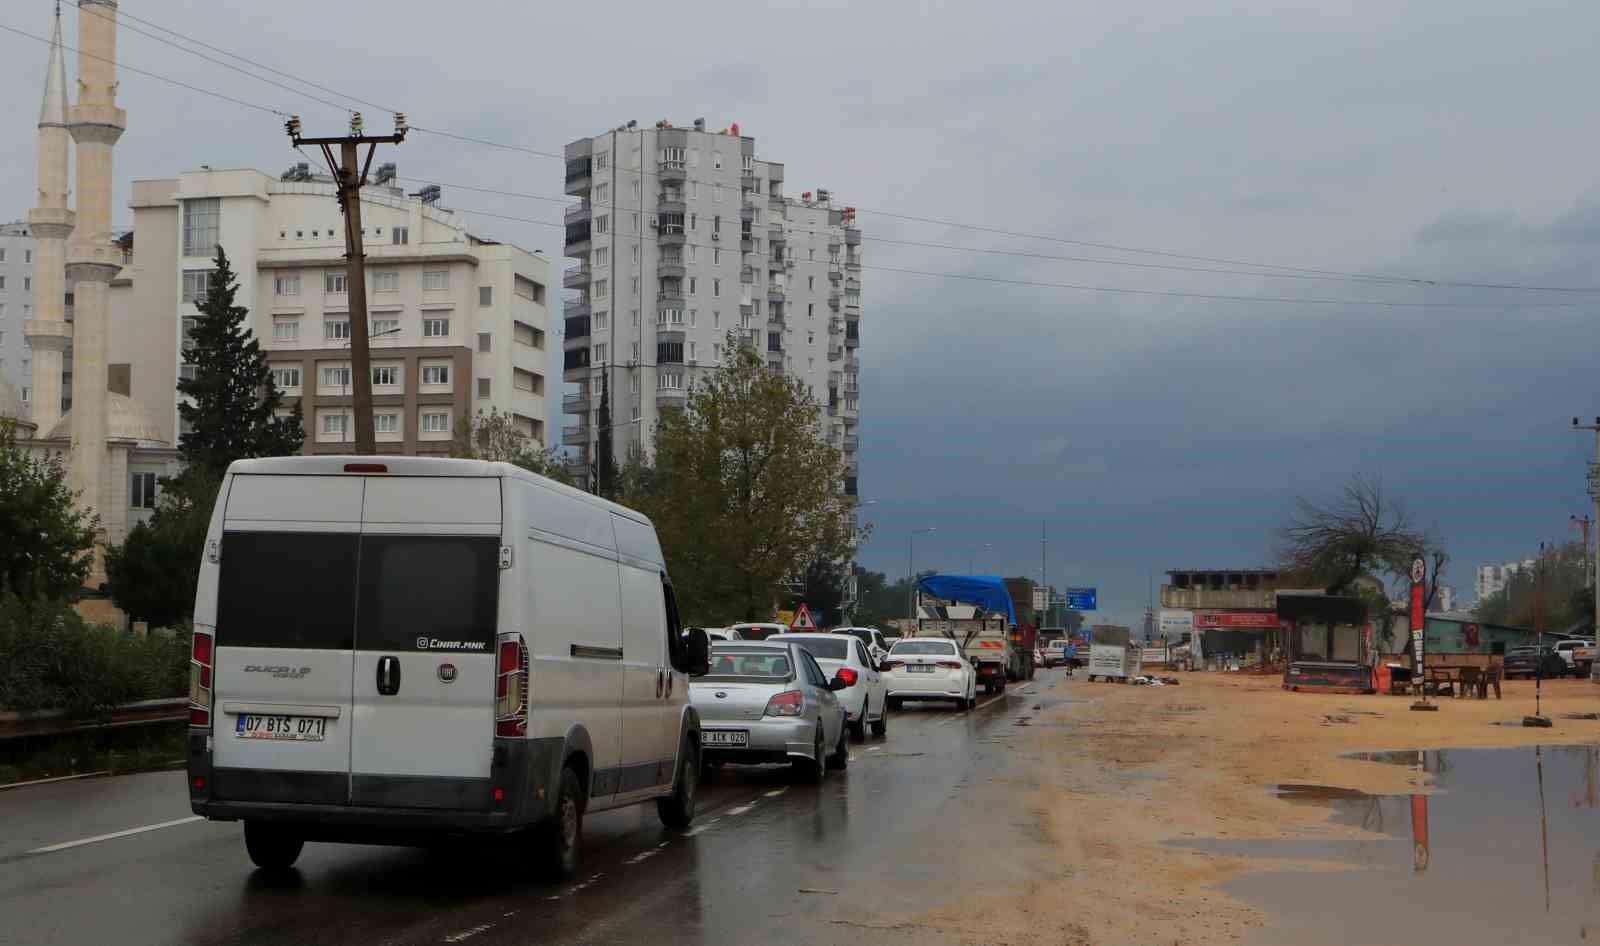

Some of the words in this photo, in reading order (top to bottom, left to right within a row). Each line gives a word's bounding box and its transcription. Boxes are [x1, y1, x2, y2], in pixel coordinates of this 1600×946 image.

[246, 716, 262, 731] 07
[266, 717, 291, 733] BTS
[298, 719, 321, 735] 071
